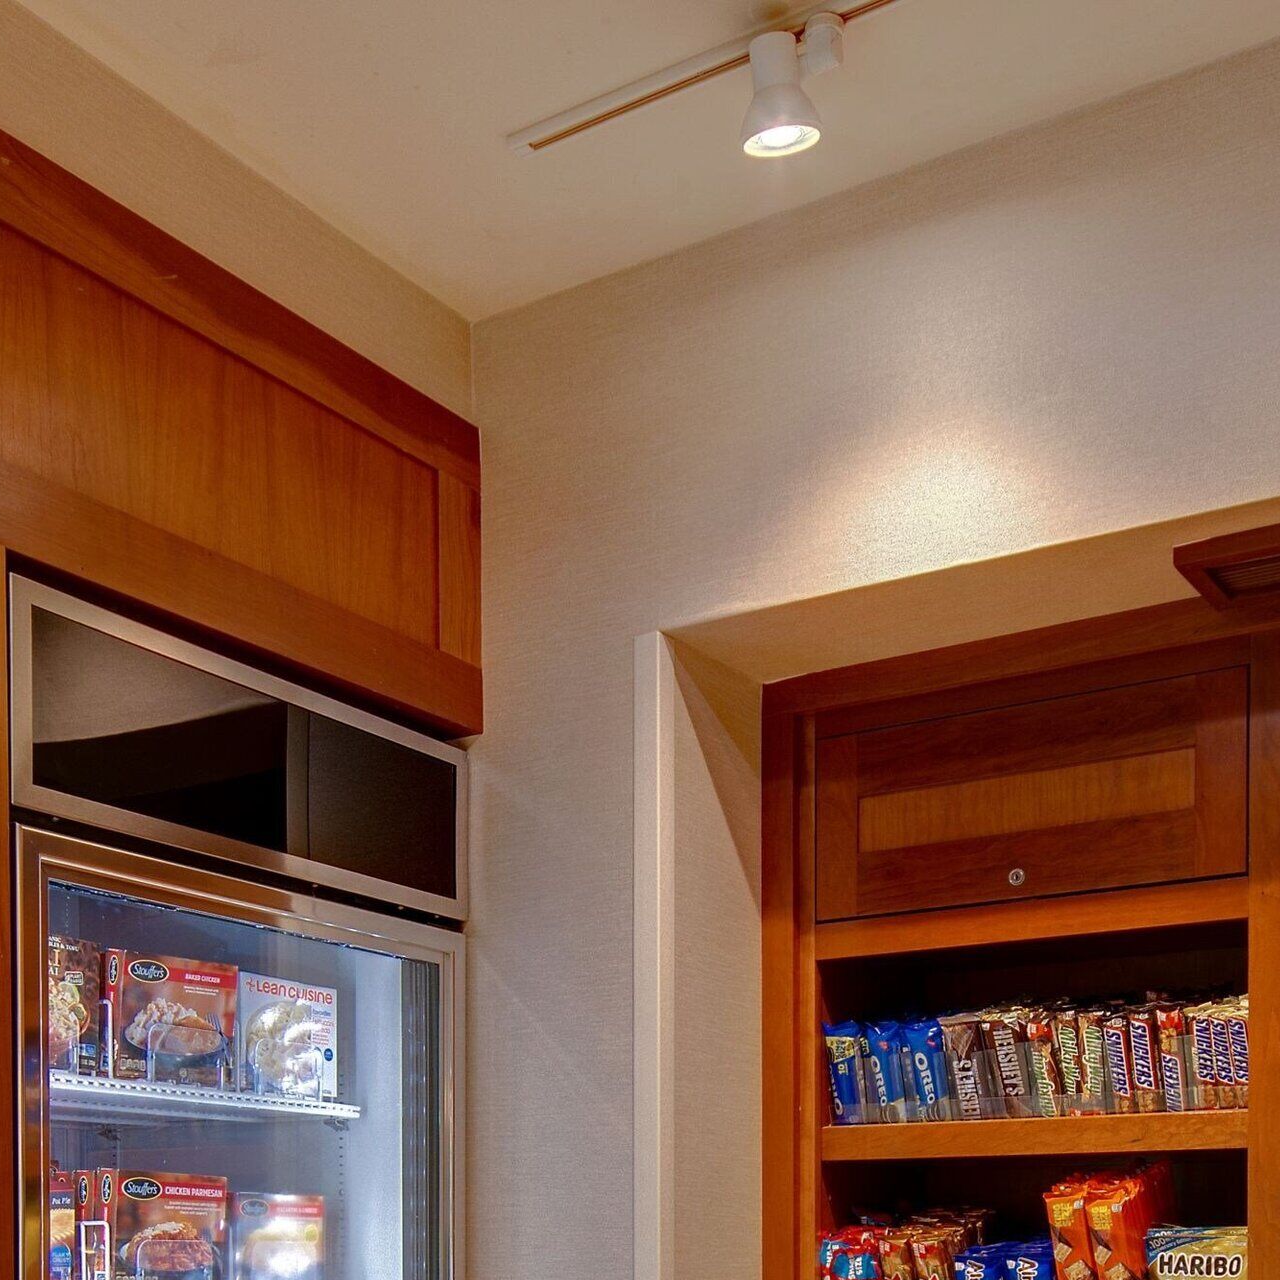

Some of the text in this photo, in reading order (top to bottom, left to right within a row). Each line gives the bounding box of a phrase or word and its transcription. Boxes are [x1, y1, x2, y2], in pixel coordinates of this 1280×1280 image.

[133, 963, 165, 979] Stouffer's
[256, 980, 287, 997] Lean
[993, 1028, 1025, 1096] HERSHEY'S
[1082, 1026, 1102, 1063] Milky
[1106, 1030, 1128, 1095] SNICKERS
[1132, 1022, 1153, 1088] SNICKERS
[1197, 1018, 1214, 1081] SNICKERS
[1211, 1019, 1233, 1083] SNICKERS
[1229, 1019, 1248, 1081] SNICKERS
[871, 1055, 887, 1107] OREO
[915, 1053, 935, 1104] OREO
[126, 1181, 159, 1196] Stouffer's
[165, 1186, 223, 1198] CHICKEN PARMESAN
[1158, 1253, 1243, 1277] HARIBO
